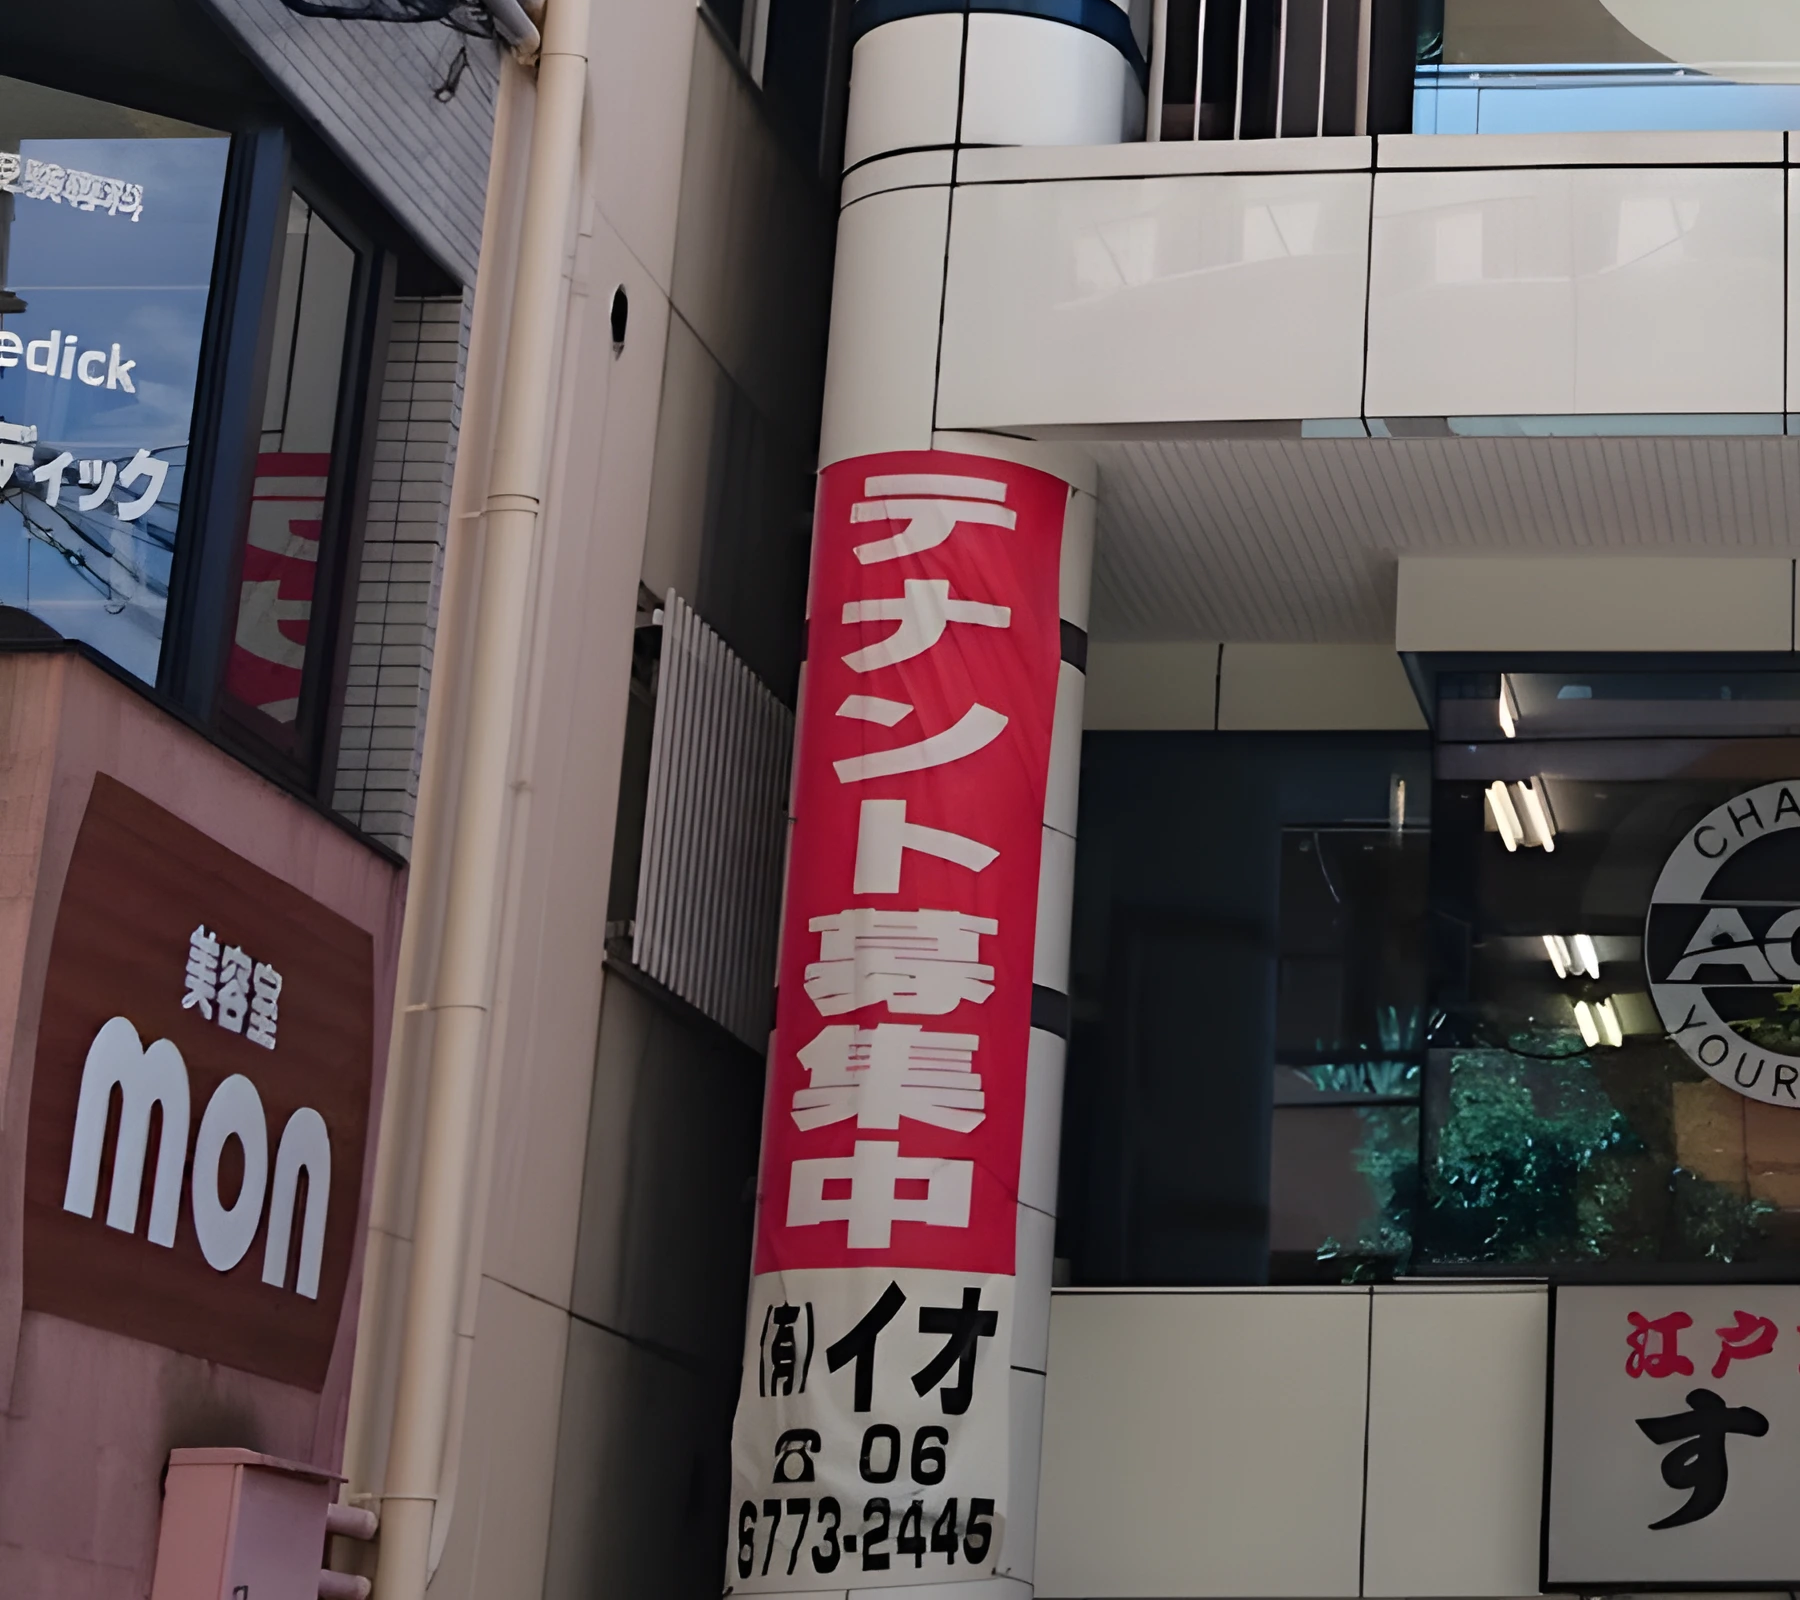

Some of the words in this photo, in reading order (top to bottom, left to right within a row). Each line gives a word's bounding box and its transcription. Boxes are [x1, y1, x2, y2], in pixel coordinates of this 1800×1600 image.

[785, 473, 1017, 1250] テナント募集中
[181, 924, 284, 1051] 美容室
[1672, 1002, 1799, 1100] YOUR
[859, 1424, 950, 1486] 06
[737, 1497, 996, 1580] 6773-2445
